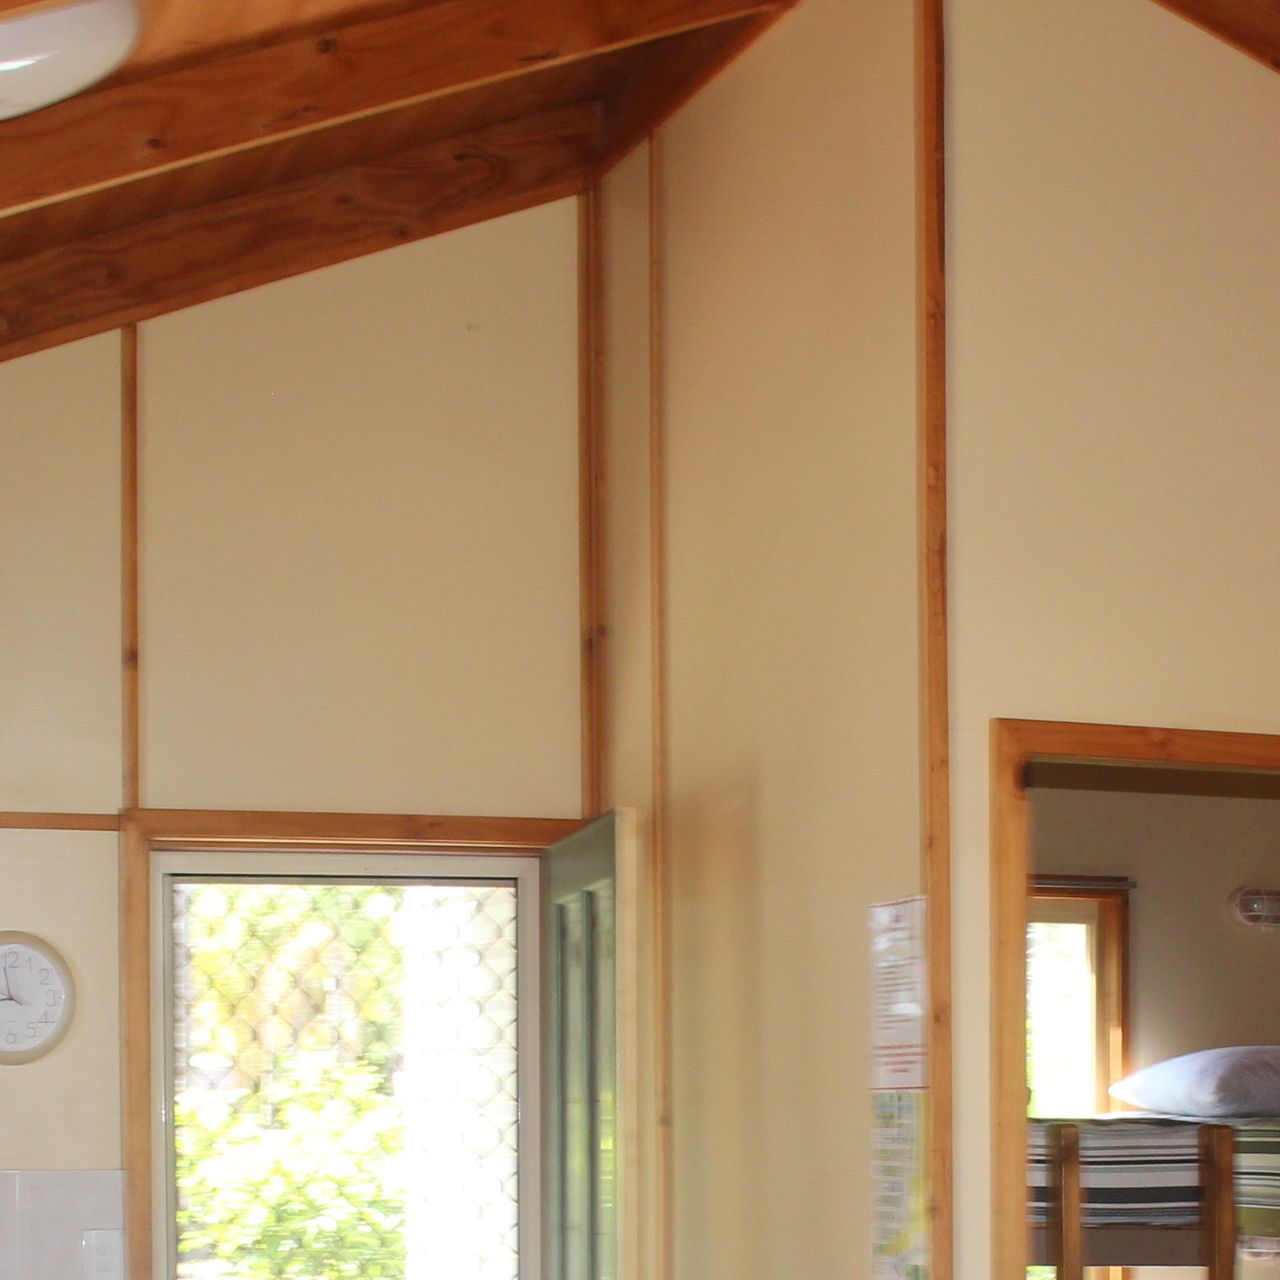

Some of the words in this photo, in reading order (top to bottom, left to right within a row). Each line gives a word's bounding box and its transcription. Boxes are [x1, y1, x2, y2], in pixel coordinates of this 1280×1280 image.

[3, 951, 18, 969] 12
[26, 956, 32, 972] 1
[39, 968, 52, 986] 2
[47, 989, 56, 1008] 3
[38, 1011, 55, 1027] 4
[5, 1028, 17, 1045] 6
[25, 1021, 36, 1039] 5
